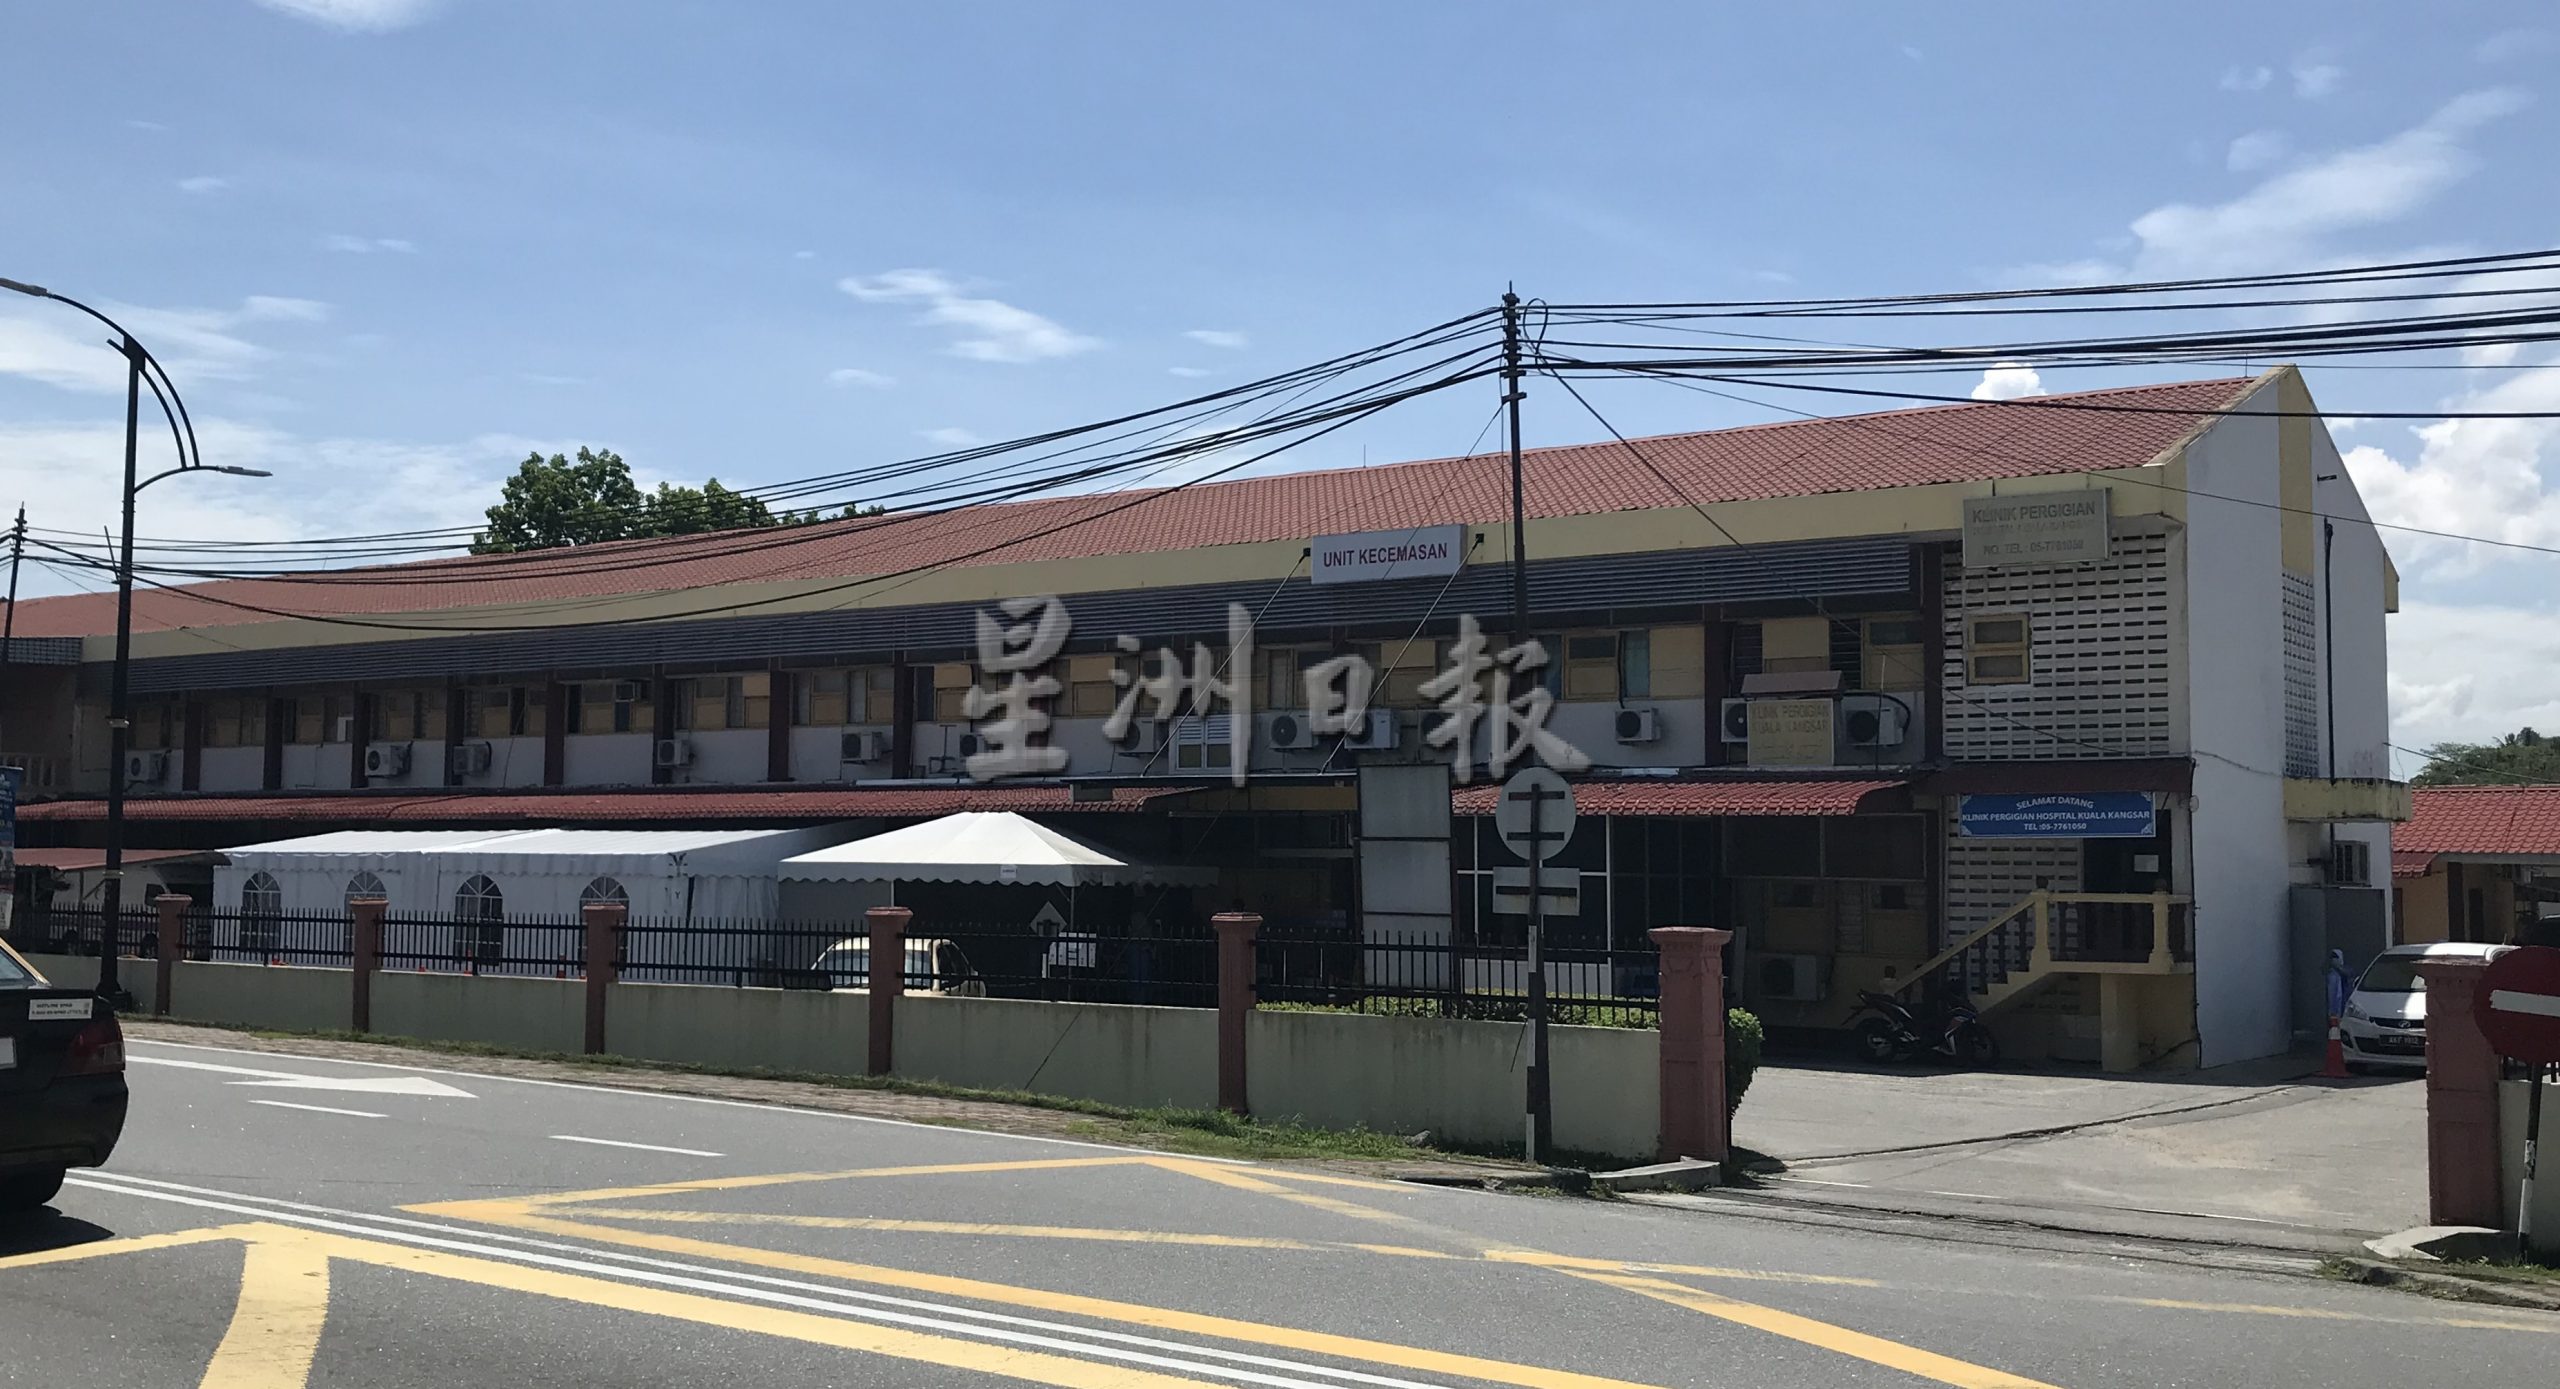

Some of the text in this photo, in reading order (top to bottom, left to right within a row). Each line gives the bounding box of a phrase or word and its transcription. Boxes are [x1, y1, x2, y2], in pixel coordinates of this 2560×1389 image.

[1972, 502, 2096, 523] KLINIK PERGIGIAN
[1323, 542, 1448, 568] UNIT KECEMASAN
[2016, 796, 2094, 810] SELAMAT DATANG
[1962, 810, 2150, 821] KLINIK PERGIGIAN HOSPITAL KUALA KANGSAR
